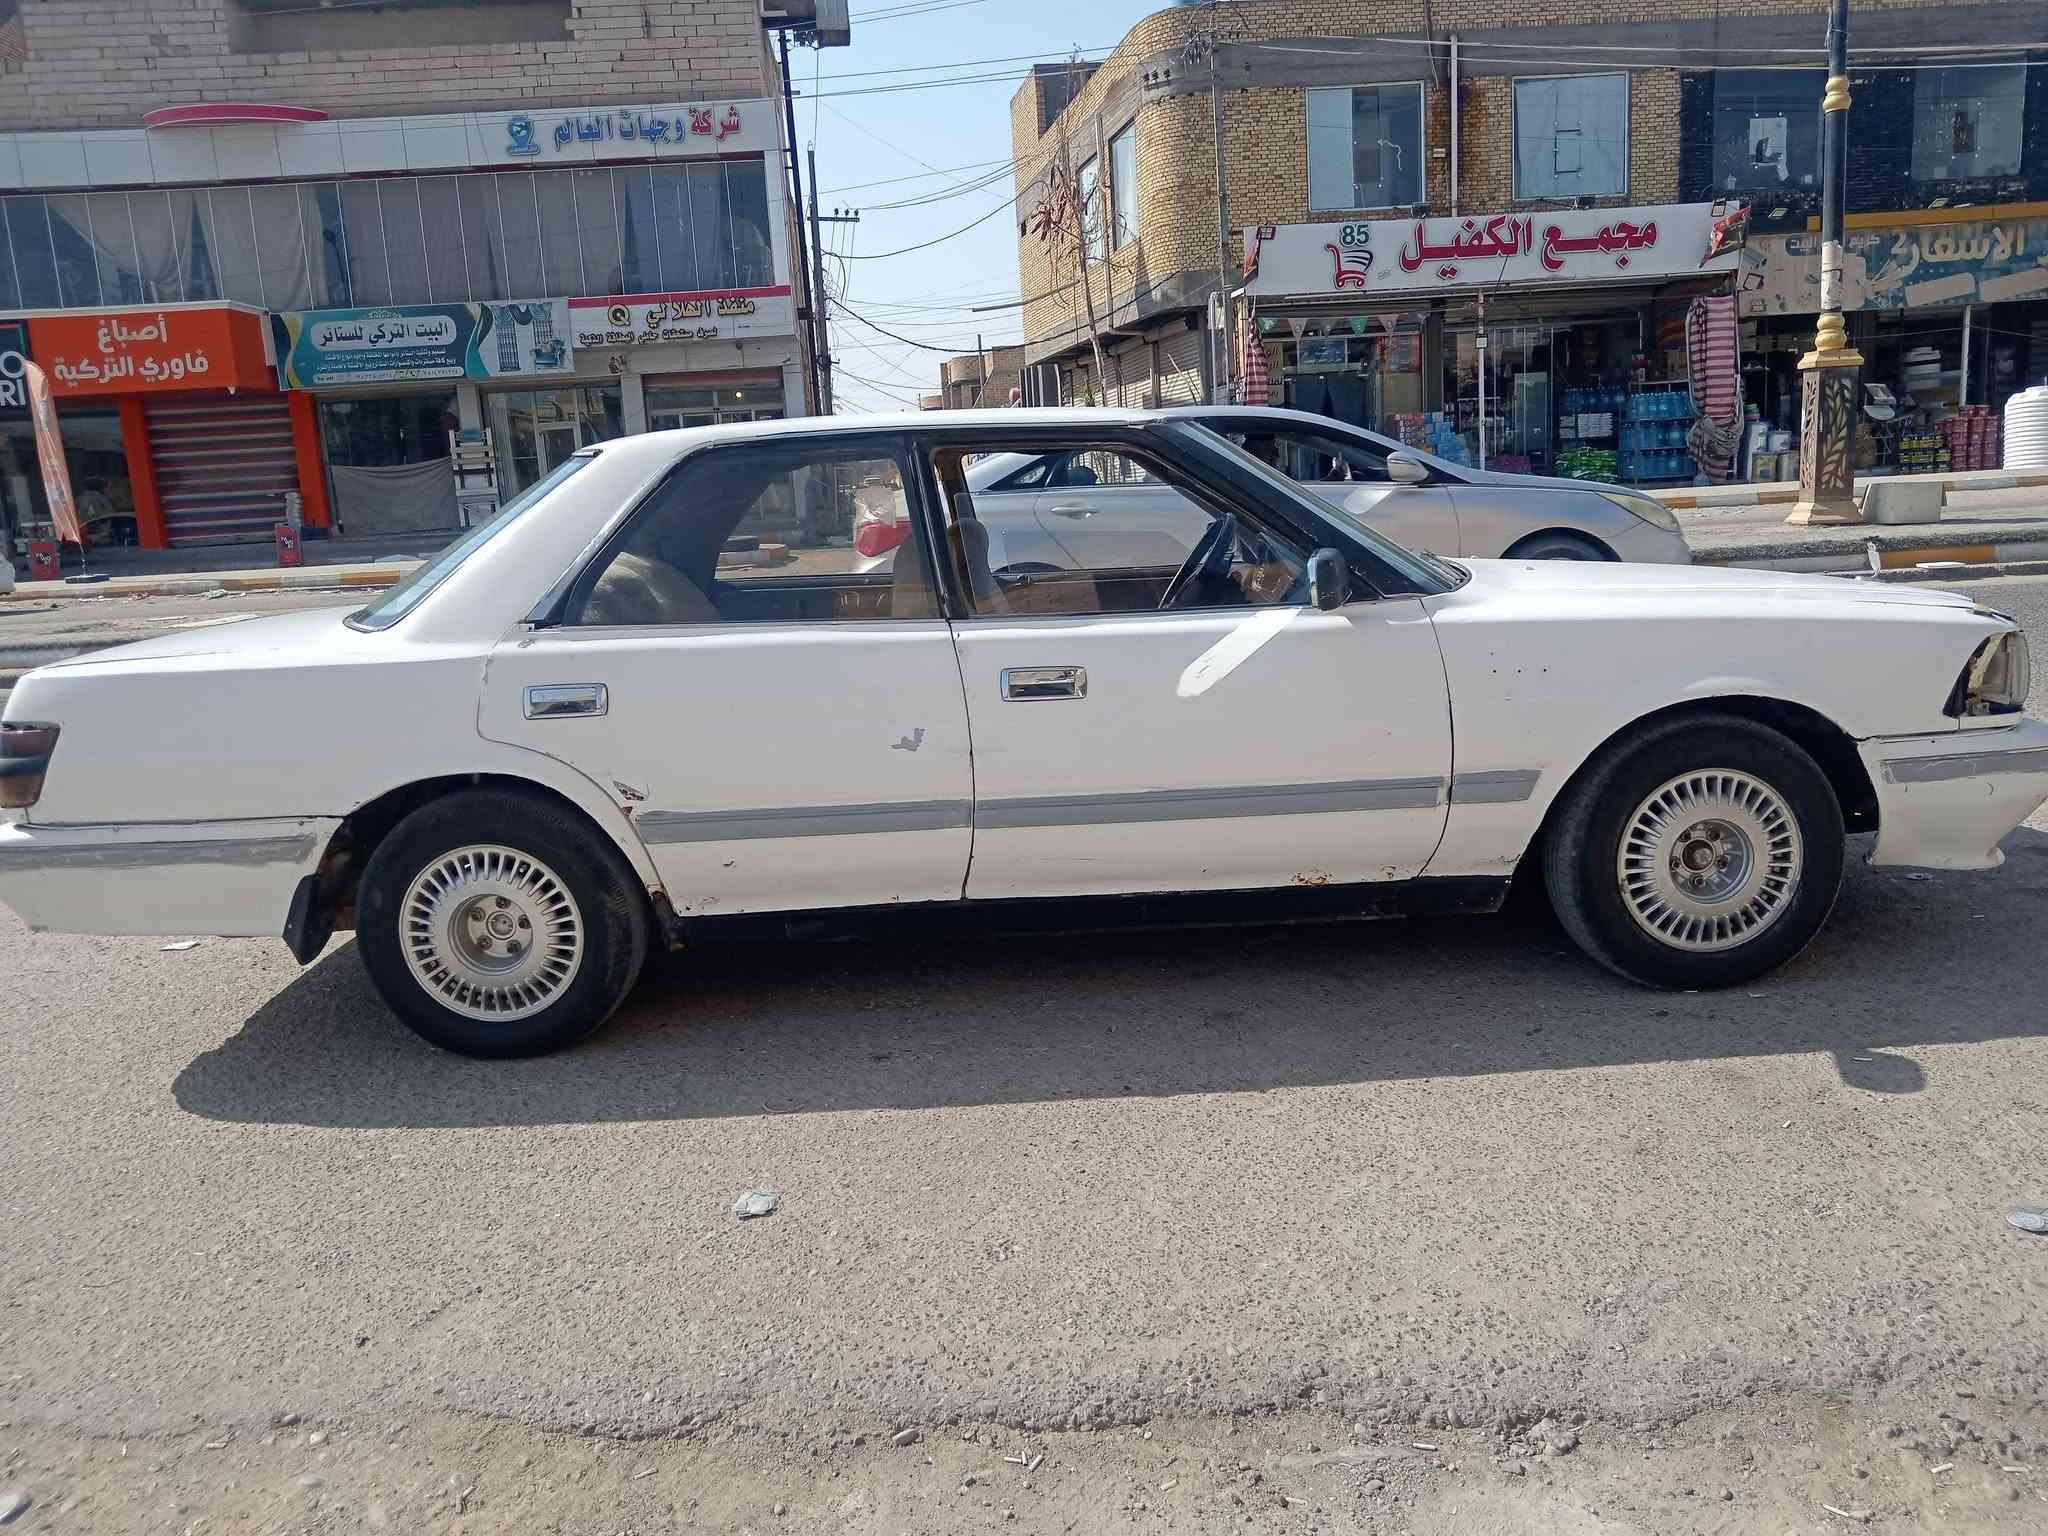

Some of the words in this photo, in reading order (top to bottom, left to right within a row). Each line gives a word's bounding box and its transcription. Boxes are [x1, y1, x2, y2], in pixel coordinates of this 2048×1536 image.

[554, 115, 614, 153] العالم
[619, 109, 687, 145] وجهات
[688, 103, 742, 142] شركة
[1339, 223, 1370, 247] 85
[1398, 214, 1533, 279] الكفيل
[1541, 216, 1658, 271] مجمع
[716, 296, 756, 316] منفذ
[97, 313, 168, 354] أصباغ
[319, 324, 364, 347] للستائر
[368, 322, 410, 347] التركي
[415, 321, 448, 342] البيت
[53, 355, 134, 388] التركية
[139, 349, 209, 383] فاوري
